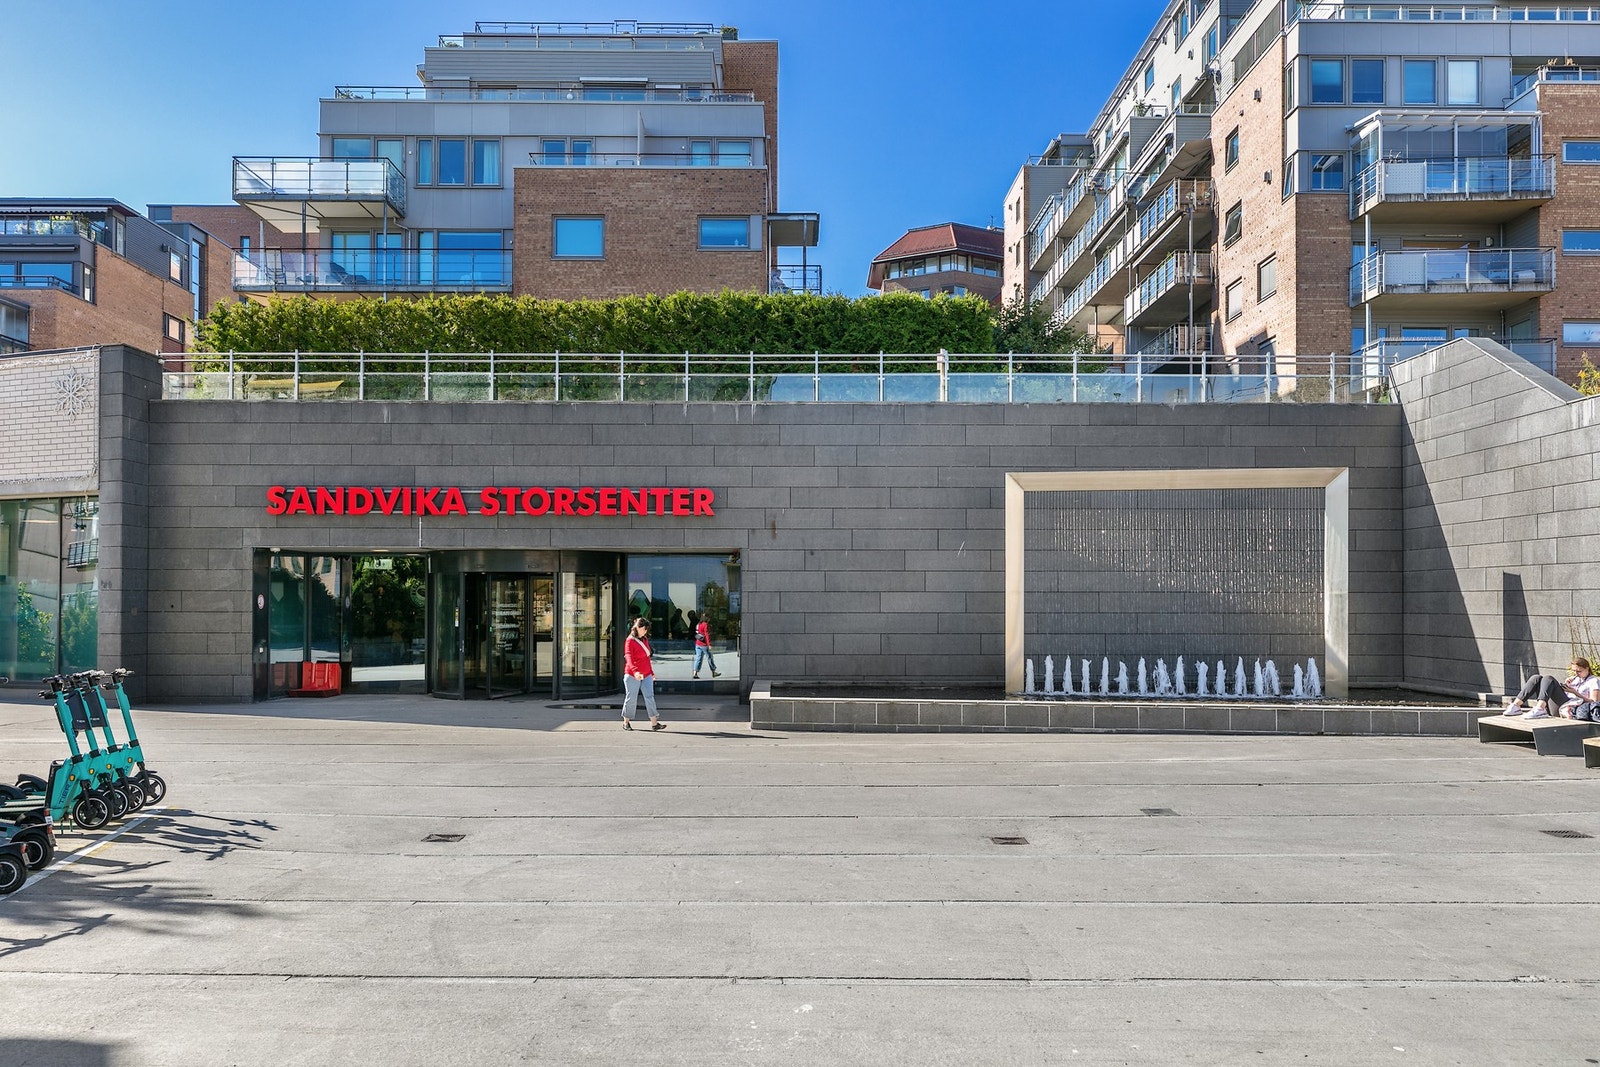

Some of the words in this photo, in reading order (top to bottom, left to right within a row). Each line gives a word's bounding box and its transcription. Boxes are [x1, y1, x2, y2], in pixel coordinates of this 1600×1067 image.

[266, 486, 468, 516] SANDVIKA
[479, 487, 716, 517] STORSENTER
[58, 782, 71, 804] TIER
